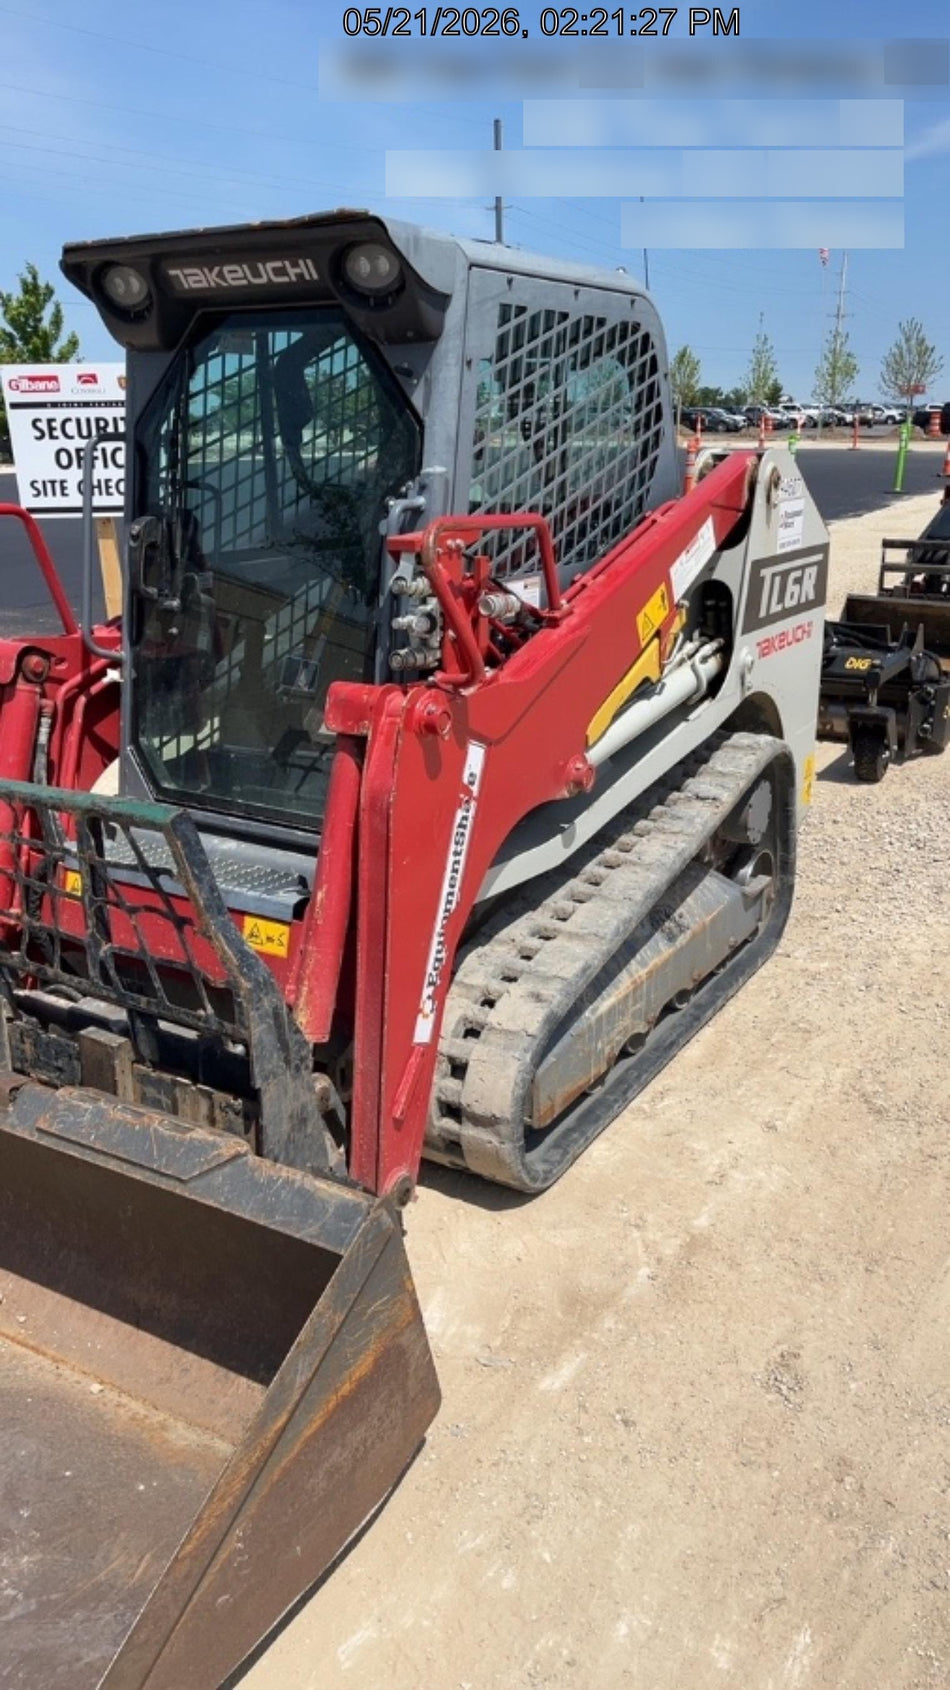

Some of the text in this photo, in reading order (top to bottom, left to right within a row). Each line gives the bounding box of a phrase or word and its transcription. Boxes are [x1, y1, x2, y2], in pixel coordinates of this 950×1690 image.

[32, 416, 125, 440] SECURI
[30, 479, 69, 498] SITE
[758, 553, 824, 619] TL6R
